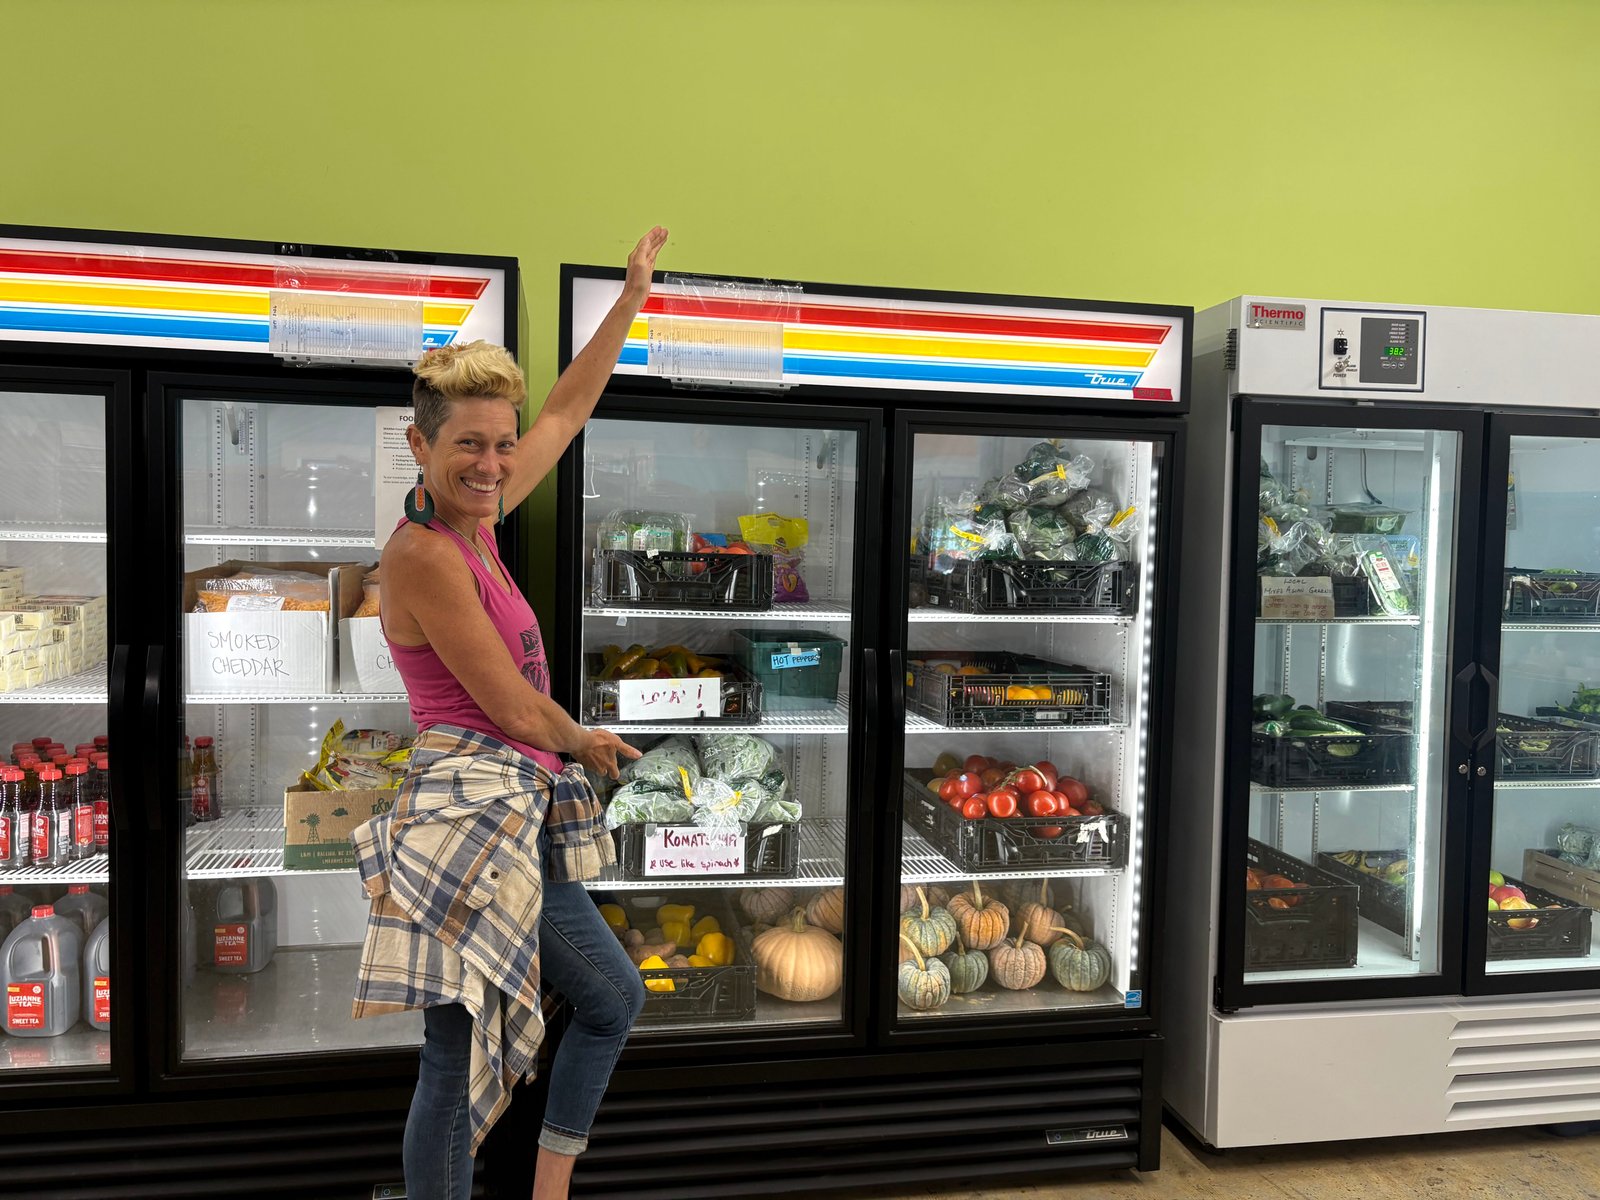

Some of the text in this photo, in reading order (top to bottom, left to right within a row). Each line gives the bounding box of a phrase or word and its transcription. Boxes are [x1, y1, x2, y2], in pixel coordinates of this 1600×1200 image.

[1252, 305, 1304, 320] Thermo
[1254, 319, 1303, 327] SCIENTIFIC
[207, 631, 281, 652] SMOKED
[212, 656, 290, 677] CHEDDAR
[773, 655, 789, 667] HOT
[681, 859, 696, 868] like
[701, 858, 733, 871] spinach
[216, 935, 244, 944] LUZIANNE
[9, 995, 41, 1005] LUZIANNE
